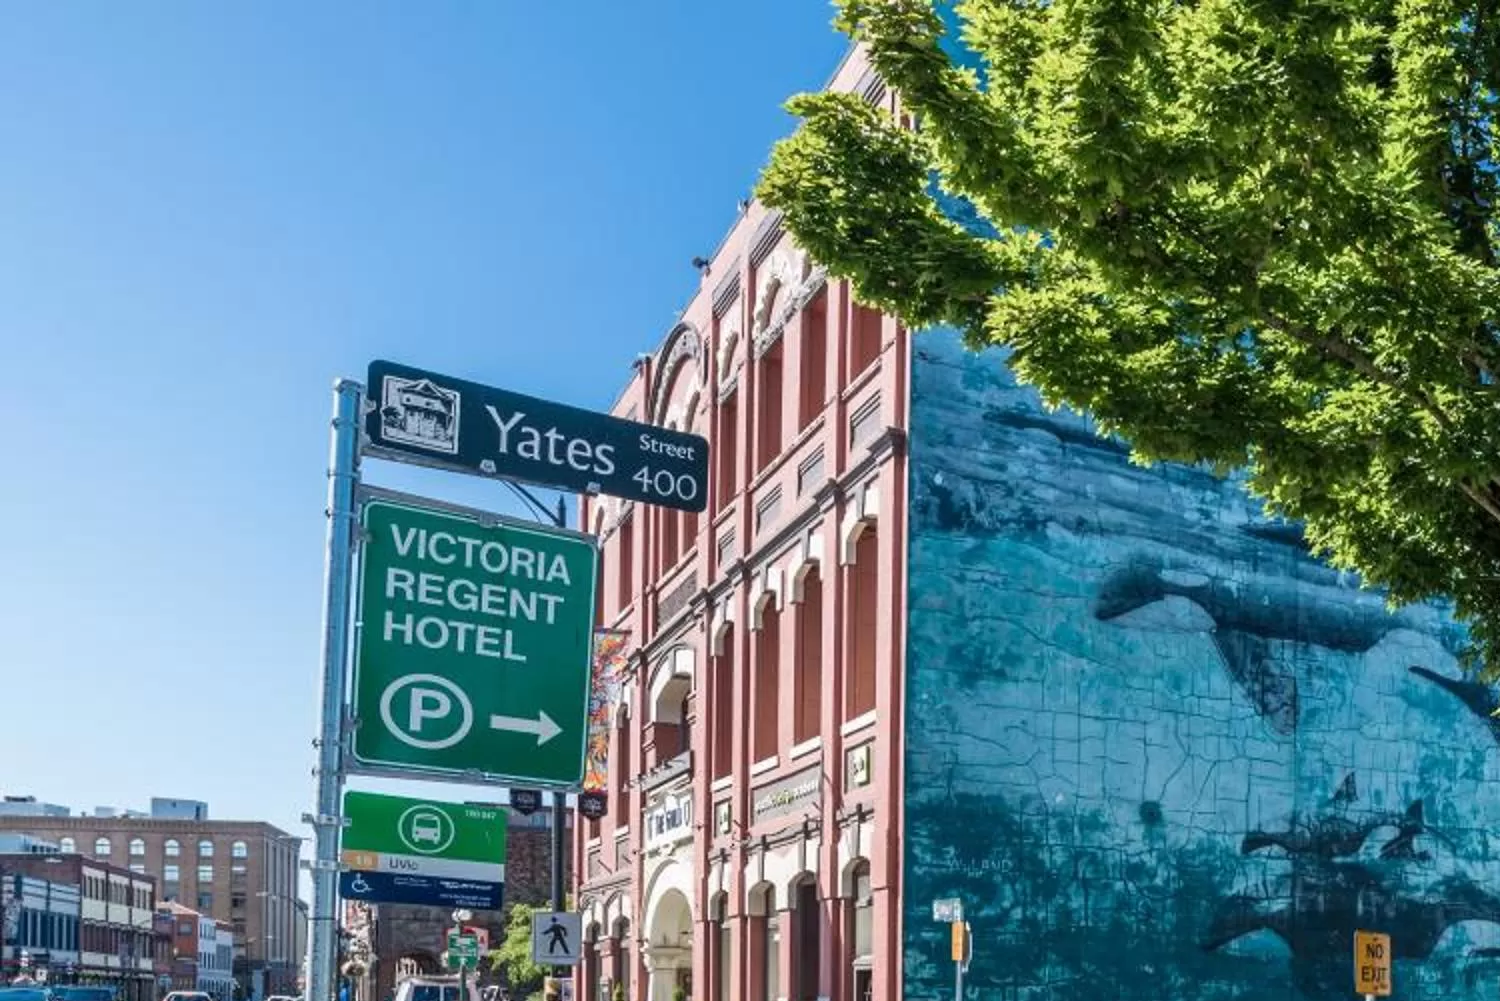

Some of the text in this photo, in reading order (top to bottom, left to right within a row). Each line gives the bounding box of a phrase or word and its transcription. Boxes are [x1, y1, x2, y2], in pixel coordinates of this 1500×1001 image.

[485, 404, 696, 475] Yates Street
[632, 466, 698, 501] 400
[390, 523, 572, 586] VICTORIA
[385, 567, 565, 625] REGENT
[383, 610, 528, 663] HOTEL
[408, 687, 451, 732] P
[1361, 965, 1388, 982] EXIT
[1365, 943, 1385, 959] NO
